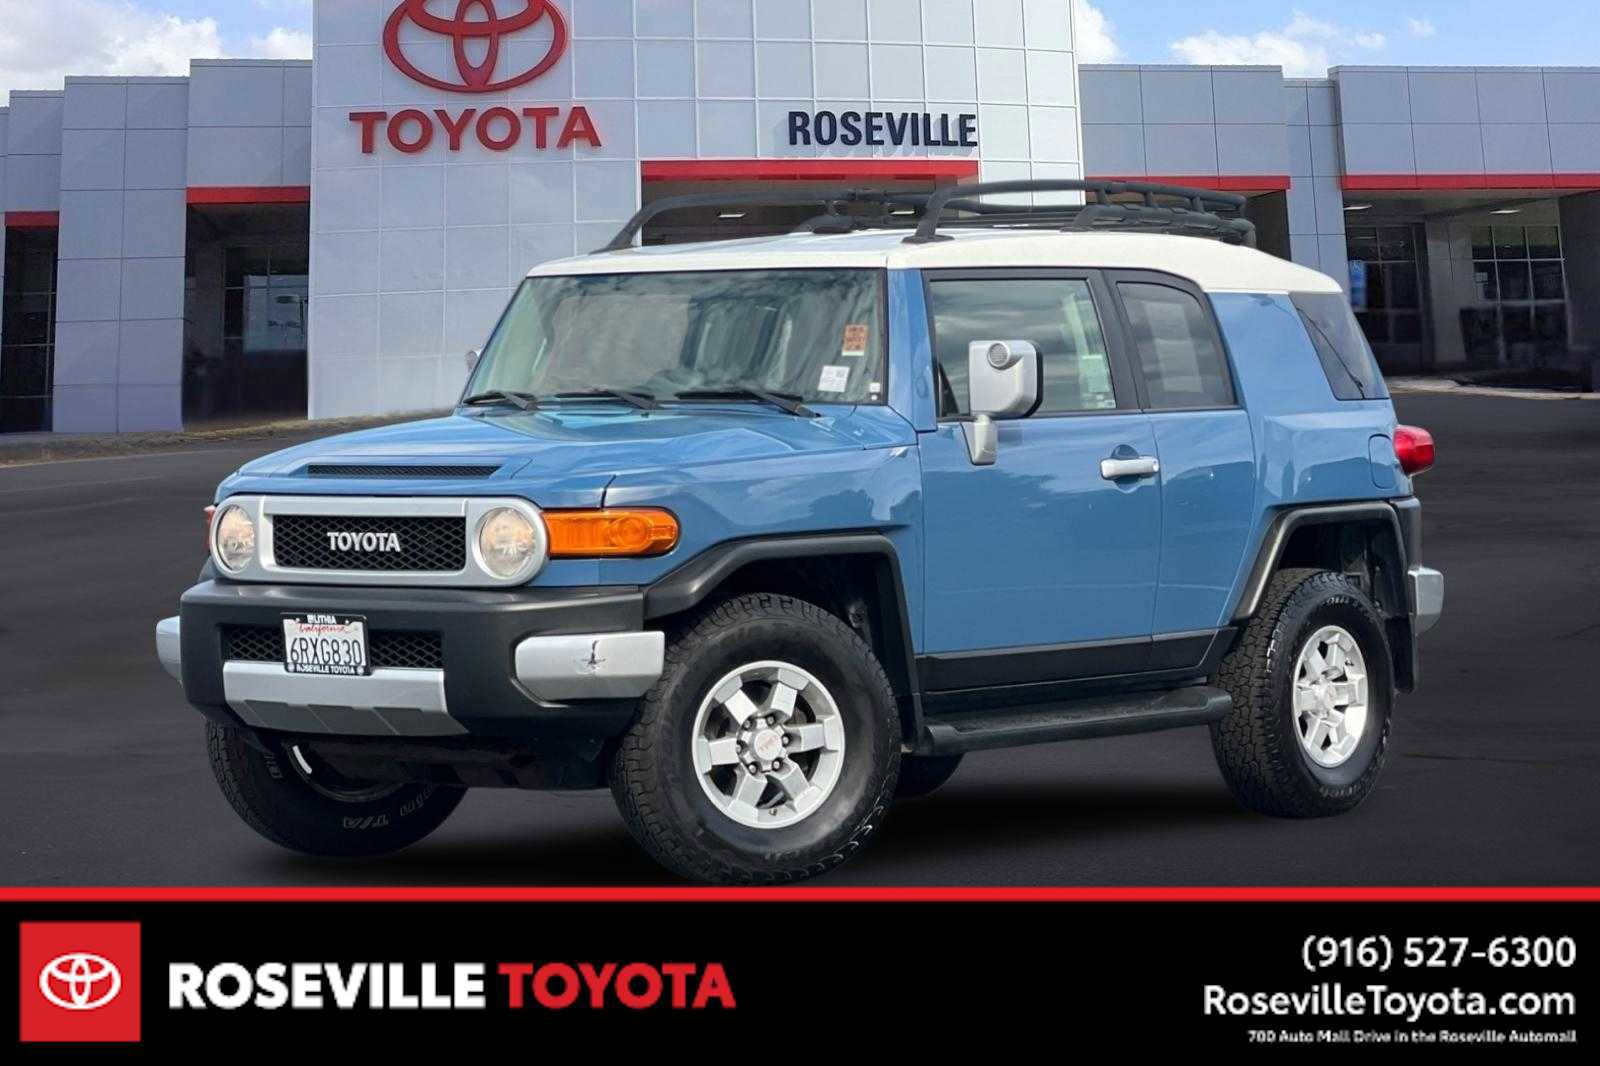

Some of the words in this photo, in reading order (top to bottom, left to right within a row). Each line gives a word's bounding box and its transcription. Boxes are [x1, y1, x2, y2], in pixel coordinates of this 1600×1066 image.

[350, 106, 602, 154] TOYOTA
[788, 110, 978, 147] ROSEVILLE
[326, 531, 401, 552] TOYOTA
[290, 637, 363, 666] 6RXG830
[296, 663, 330, 673] ROSEVILLE
[331, 665, 356, 675] TOYOTA
